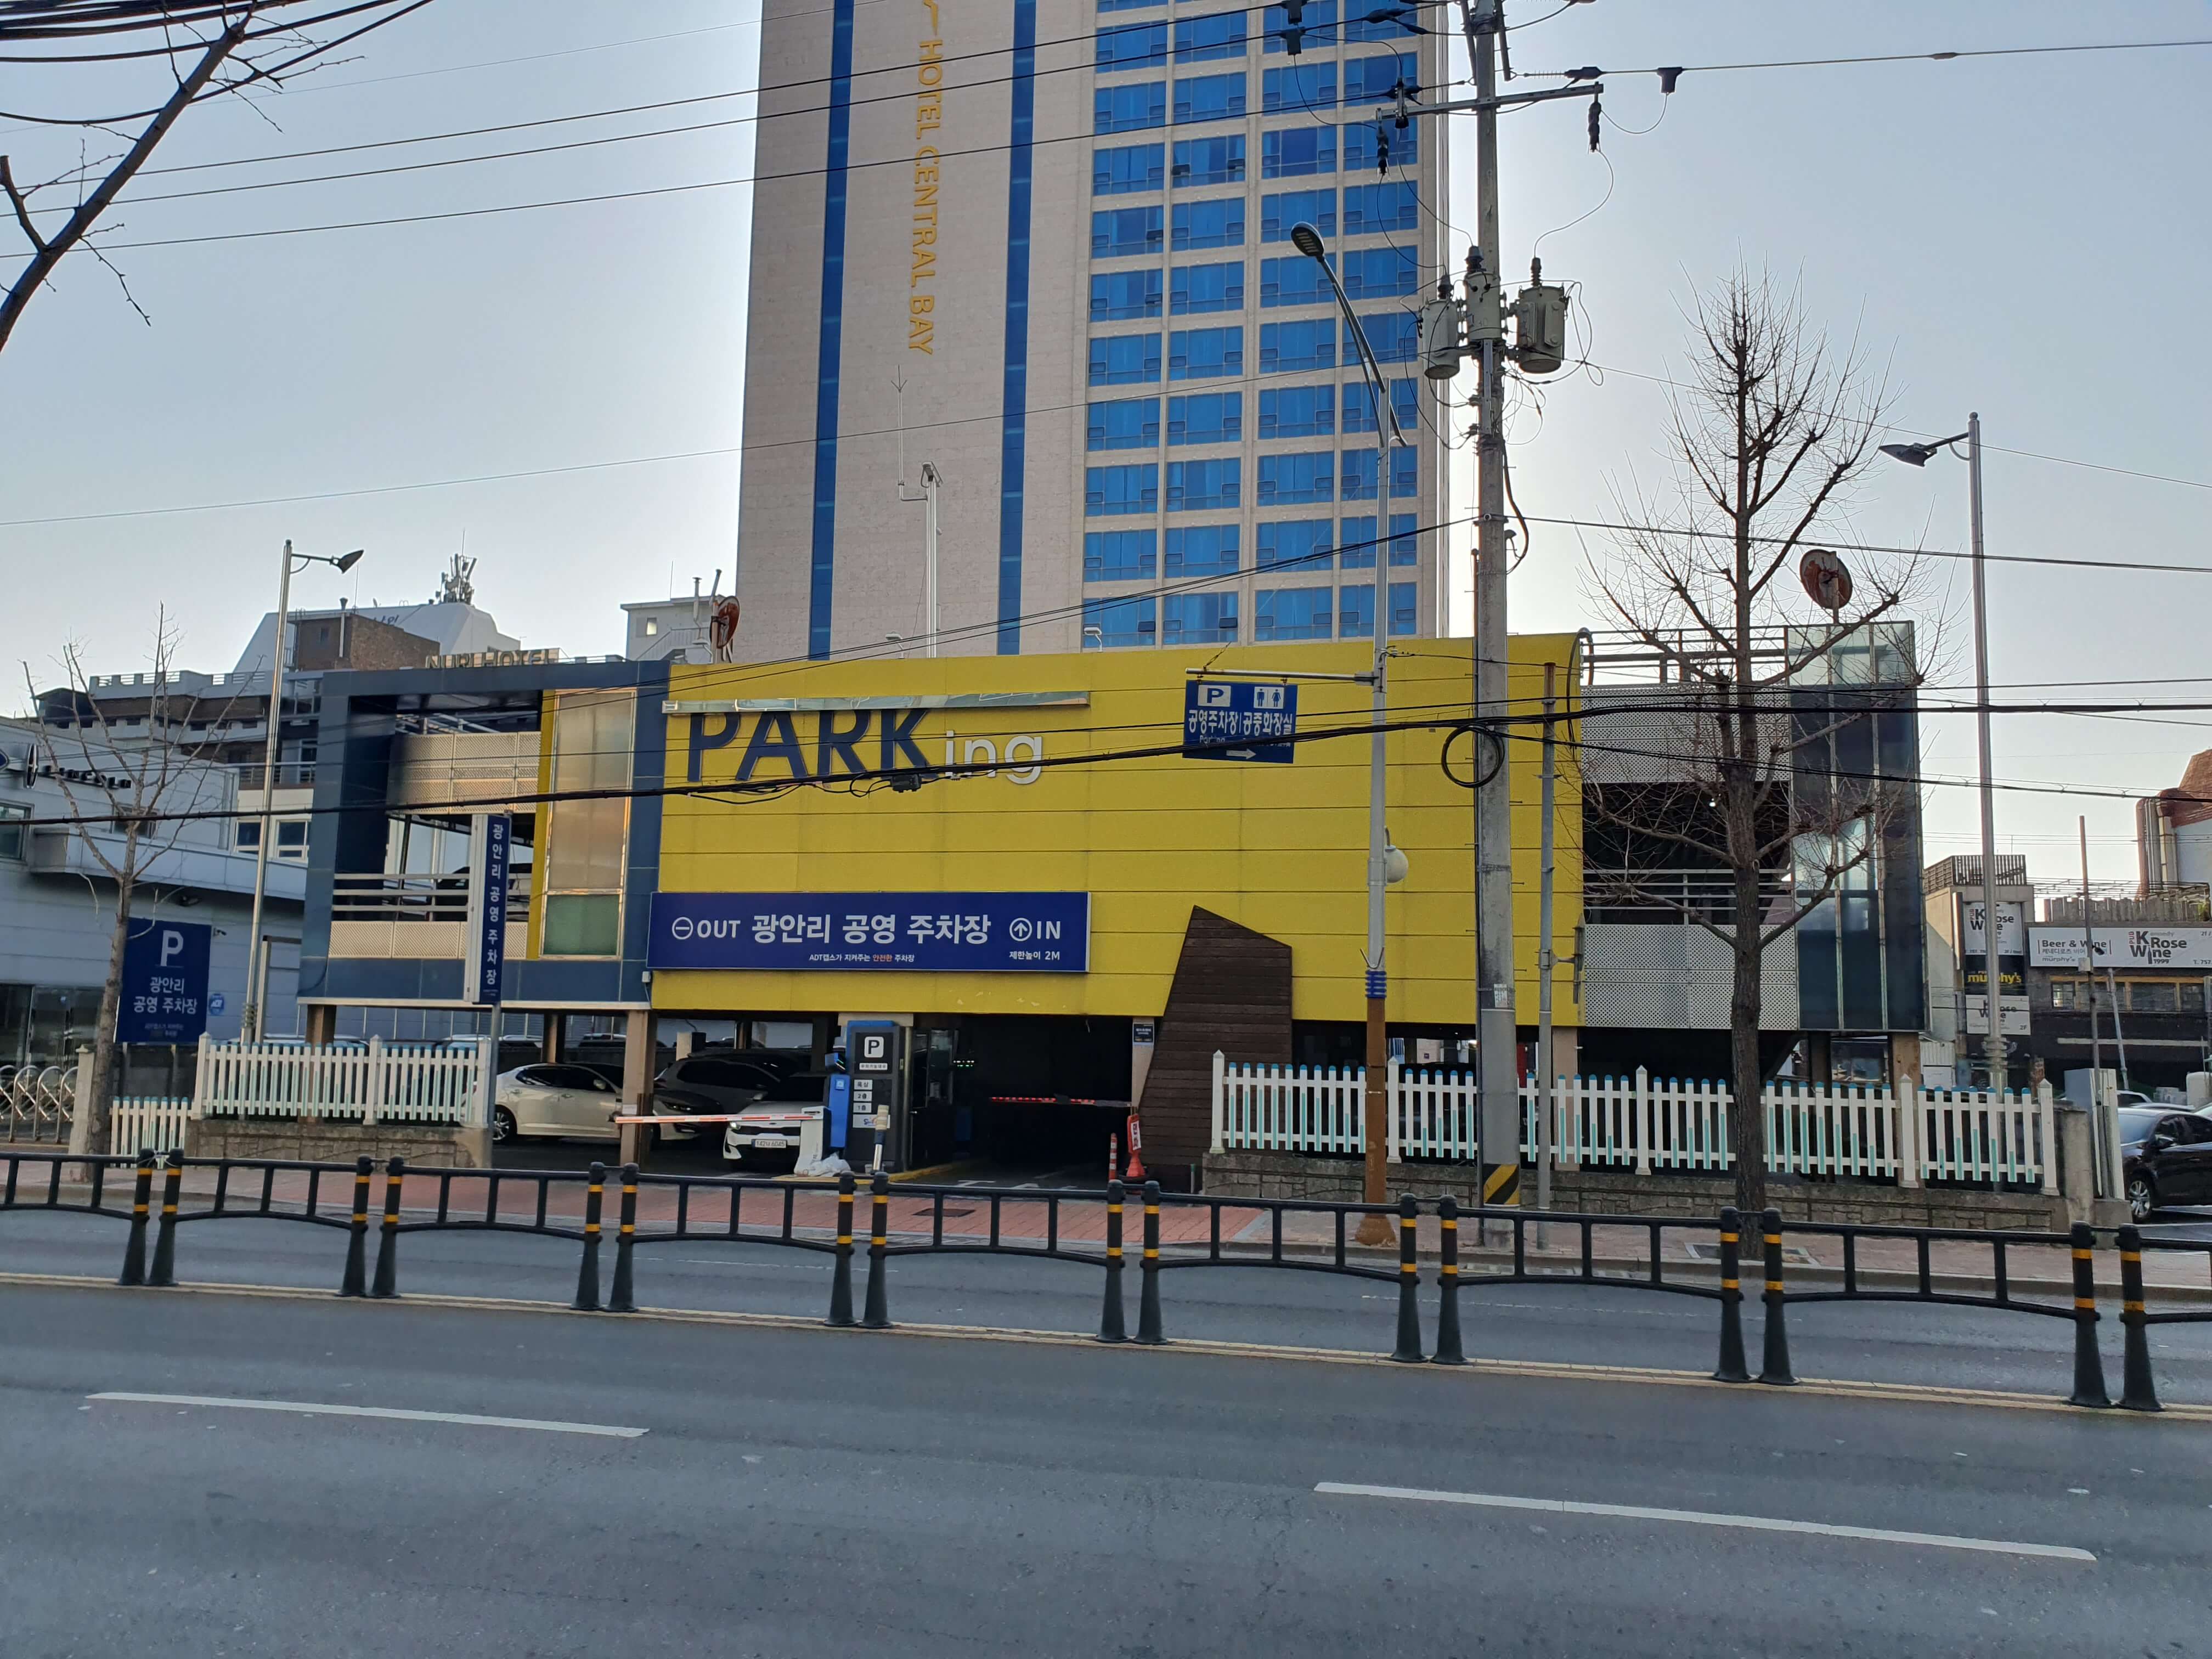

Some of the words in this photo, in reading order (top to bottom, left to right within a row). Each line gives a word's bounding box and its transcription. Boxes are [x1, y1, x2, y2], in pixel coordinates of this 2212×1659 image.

[916, 39, 943, 140] HOTEL
[912, 145, 939, 288] CENTRAL
[909, 295, 935, 355] BAY
[1207, 688, 1224, 703] P
[1189, 709, 1239, 735] 공영주차장
[1243, 712, 1293, 737] 공중화장실
[491, 824, 504, 880] 광안리
[489, 886, 500, 923] 공영
[697, 920, 741, 939] OUT
[752, 915, 831, 944] 광안리
[842, 915, 896, 944] 공영
[907, 915, 992, 945] 주차장
[1037, 921, 1061, 939] IN
[1971, 920, 2003, 930] We
[160, 930, 184, 967] P
[2151, 937, 2187, 949] Rose
[486, 929, 498, 985] 주차장
[895, 954, 915, 963] 주차장
[1009, 951, 1041, 961] 제한높이
[1045, 951, 1060, 961] 2M
[150, 977, 185, 995] 광안리
[133, 996, 158, 1013] 공영
[162, 997, 198, 1015] 주차장
[868, 1040, 880, 1054] P
